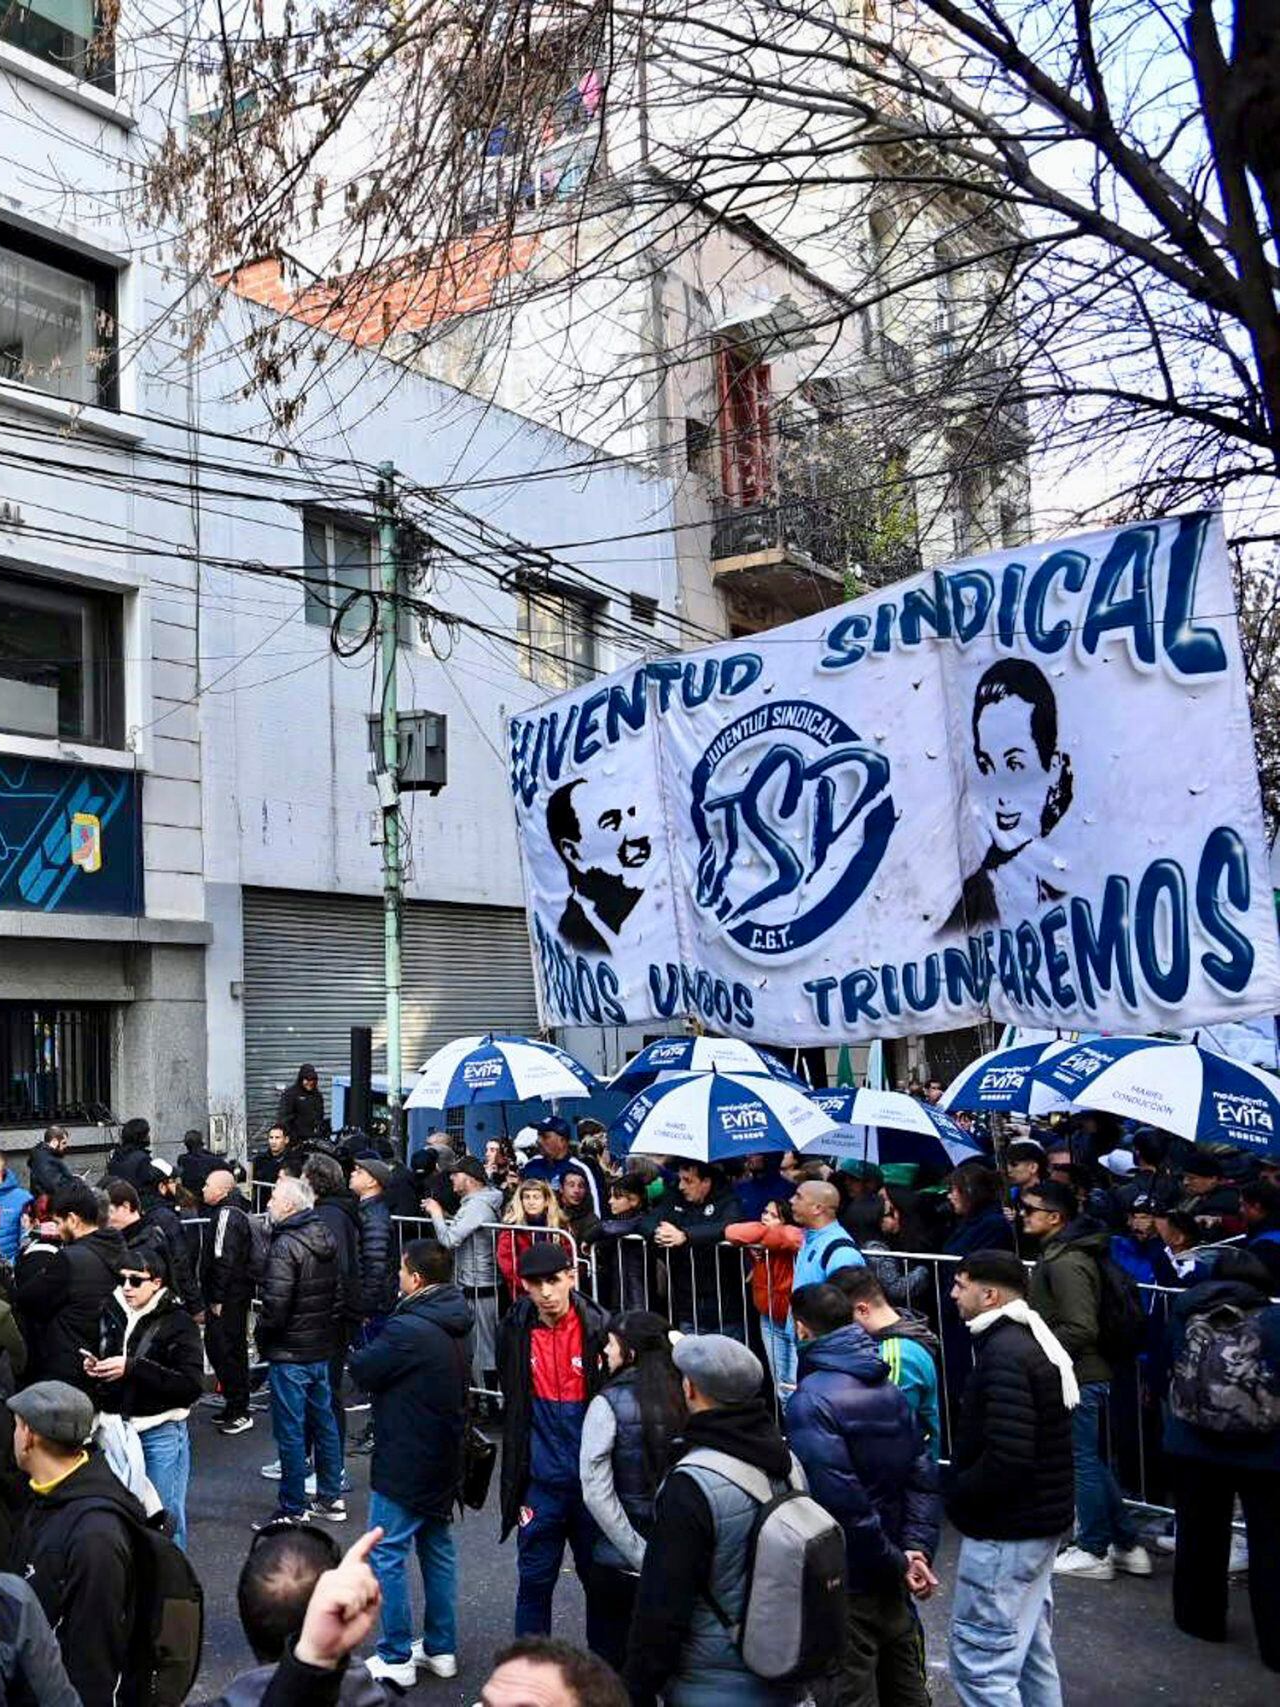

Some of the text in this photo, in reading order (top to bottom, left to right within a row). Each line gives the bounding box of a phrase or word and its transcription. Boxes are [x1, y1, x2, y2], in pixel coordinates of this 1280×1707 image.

[820, 511, 1227, 675] SINDICAL
[705, 704, 840, 771] JUVENTUD SINDICAL
[649, 962, 755, 1028] UNDOS
[804, 826, 1255, 1027] TRIUNFAREMOS
